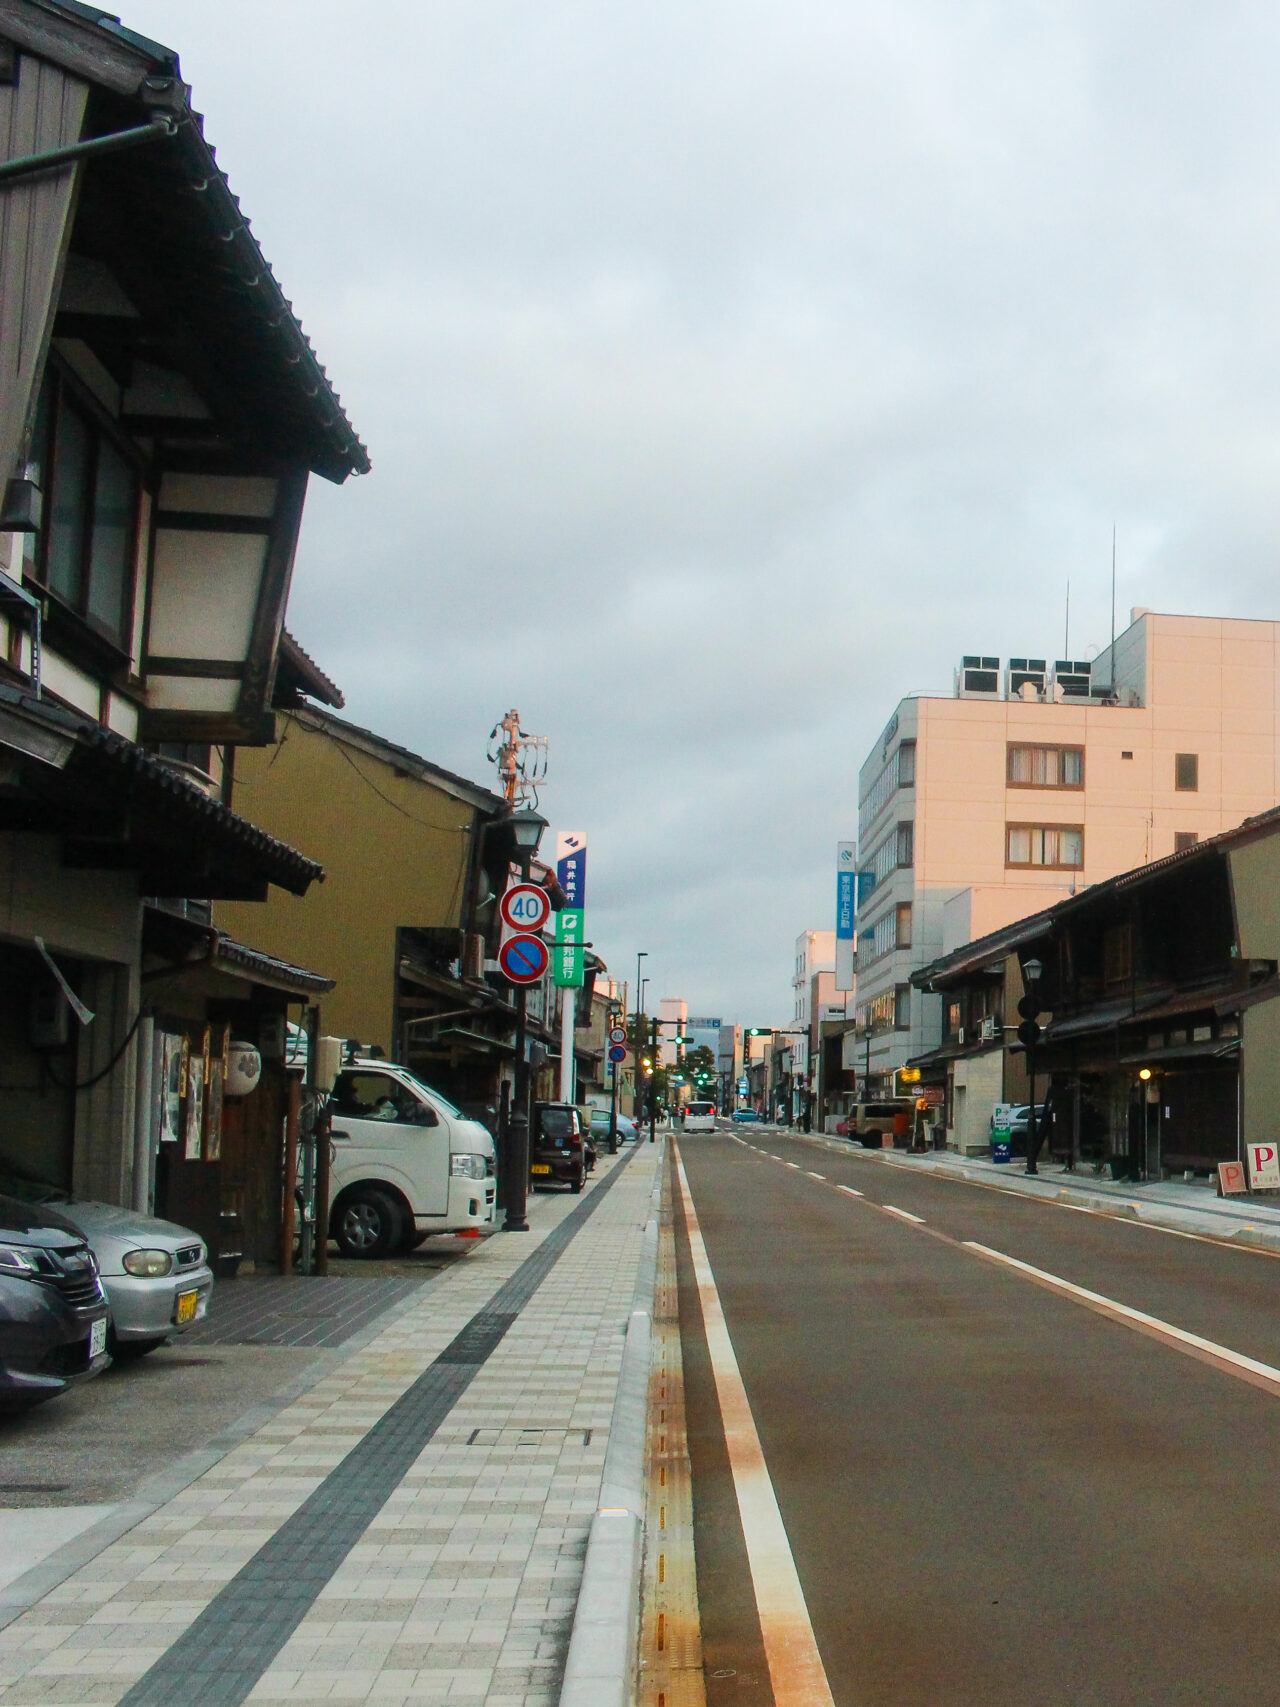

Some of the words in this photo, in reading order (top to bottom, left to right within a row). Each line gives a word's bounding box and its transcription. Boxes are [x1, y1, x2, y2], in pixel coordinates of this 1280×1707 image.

[512, 897, 539, 919] 40
[612, 1031, 623, 1041] 40
[995, 1107, 1002, 1117] P
[1253, 1147, 1274, 1172] P
[1225, 1166, 1240, 1185] P
